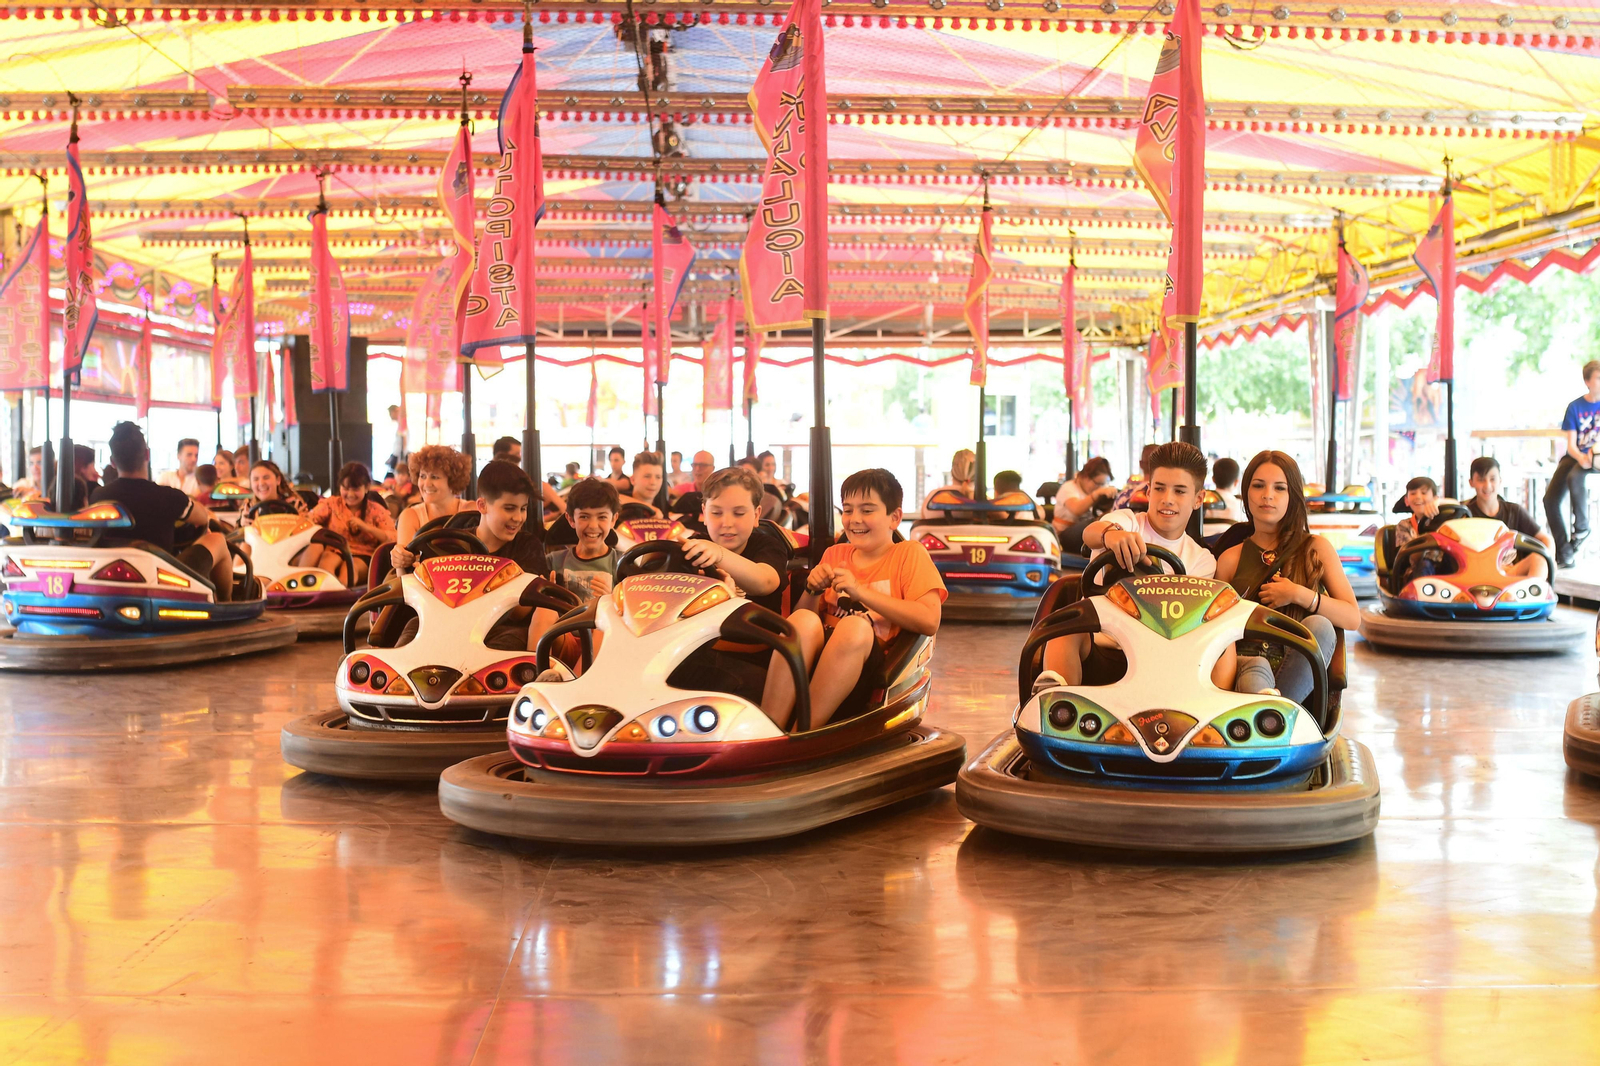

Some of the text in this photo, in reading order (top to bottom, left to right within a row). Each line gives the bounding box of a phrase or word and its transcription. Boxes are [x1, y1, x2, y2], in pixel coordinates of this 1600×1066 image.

[644, 531, 657, 541] 16
[432, 555, 500, 565] AUTOSPORT
[969, 547, 986, 564] 19
[432, 564, 495, 572] ANDALUCIA
[630, 574, 706, 584] AUTOSPORT
[1133, 576, 1217, 588] AUTOSPORT
[45, 575, 64, 595] 18
[445, 578, 473, 594] 23
[627, 584, 696, 594] ANDALUCIA
[1136, 587, 1213, 597] ANDALUCIA
[633, 600, 667, 619] 29
[1160, 600, 1185, 619] 10
